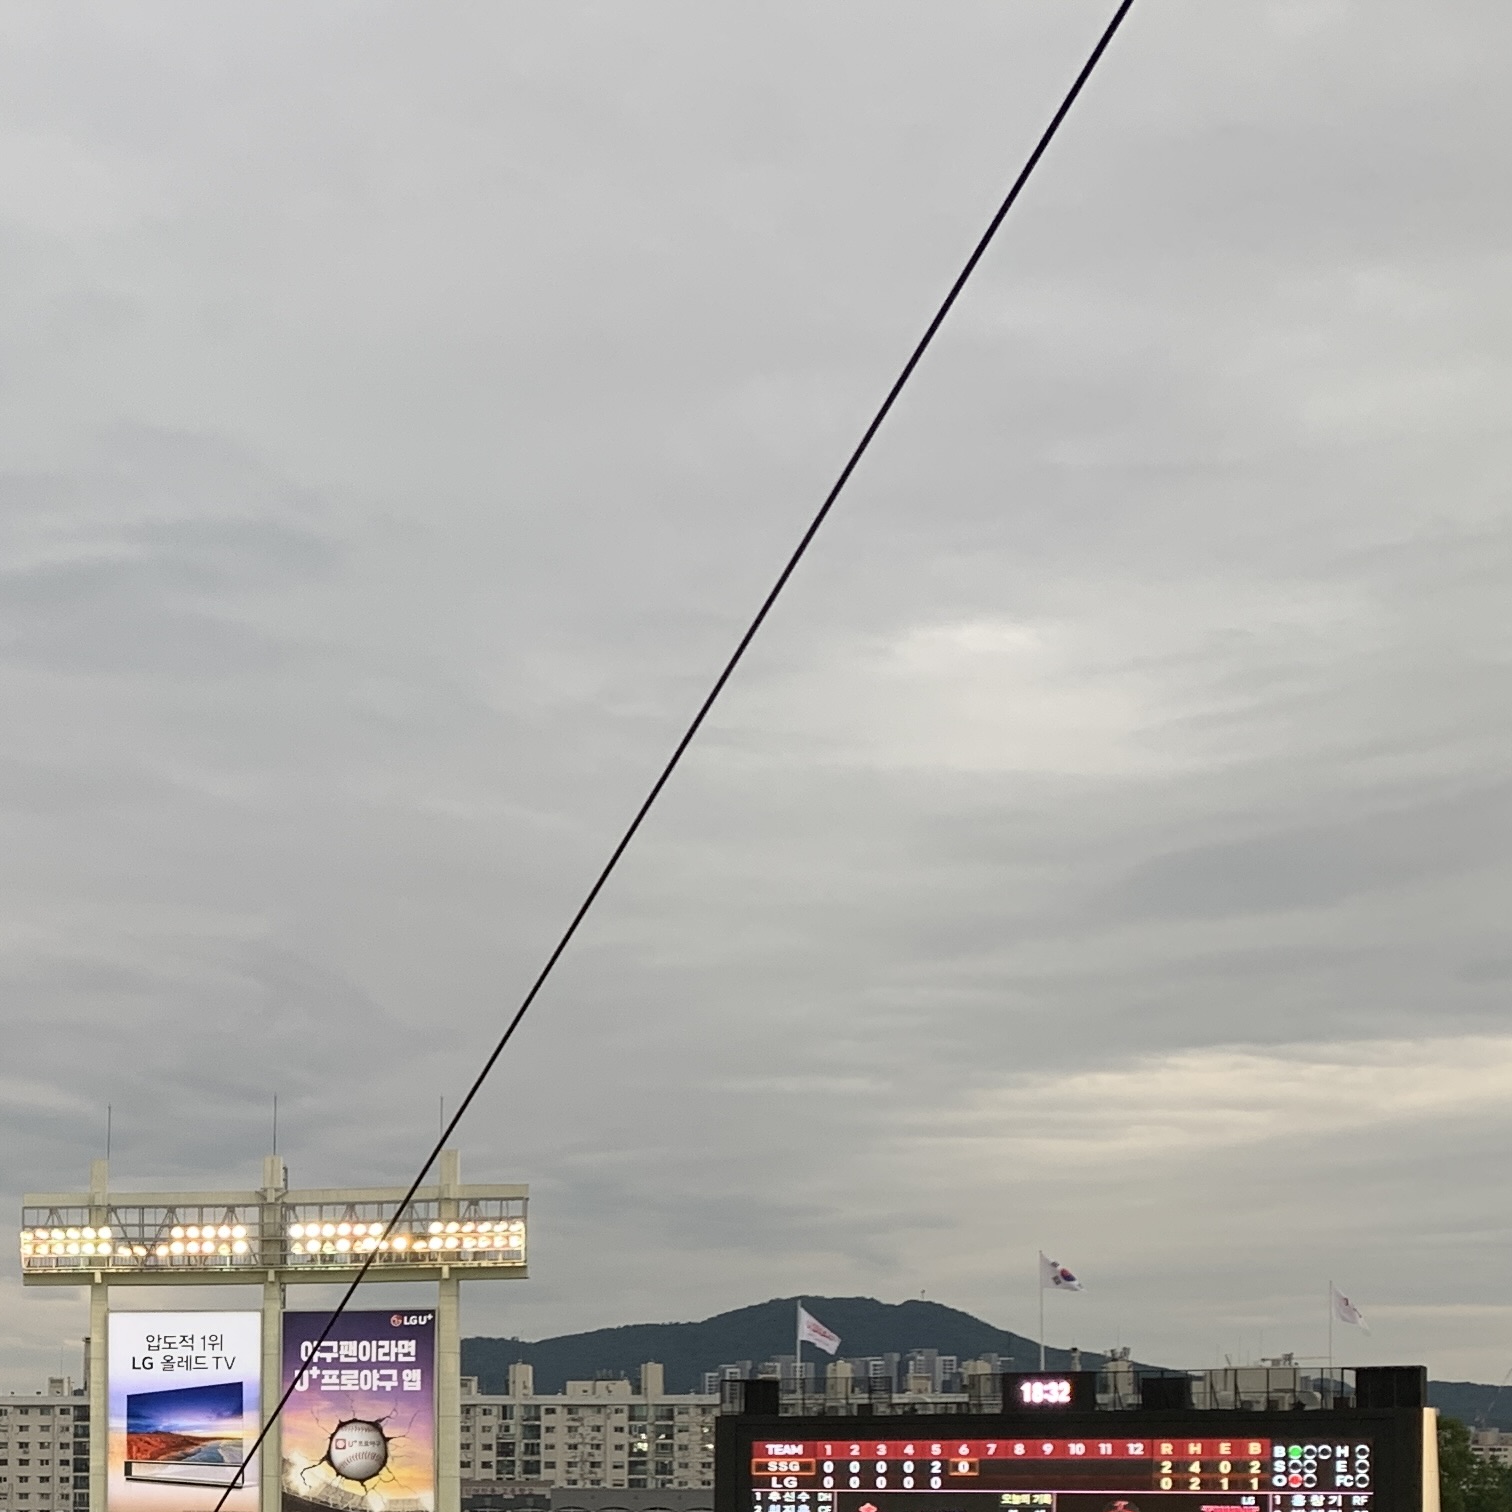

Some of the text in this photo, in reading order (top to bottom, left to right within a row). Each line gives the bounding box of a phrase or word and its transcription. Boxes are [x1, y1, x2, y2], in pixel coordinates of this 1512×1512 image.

[403, 1316, 417, 1326] LG
[145, 1333, 223, 1351] 압도적 1위
[300, 1340, 417, 1362] 야구팬이라면
[132, 1354, 236, 1371] LG 올레드 TV
[402, 1368, 422, 1391] 앱
[765, 1442, 1261, 1455] TEAM 1 2 3 4 5 6 7 8 9 10 11 12 R H E B
[767, 1461, 801, 1473] SSG
[1161, 1461, 1172, 1473] 2
[1189, 1461, 1200, 1473] 4
[1219, 1461, 1231, 1473] 0
[1250, 1461, 1260, 1473] 2
[772, 1477, 797, 1488] LG
[1161, 1477, 1172, 1490] 0
[1190, 1477, 1200, 1490] 2
[1220, 1478, 1228, 1490] 1
[1250, 1478, 1258, 1490] 1
